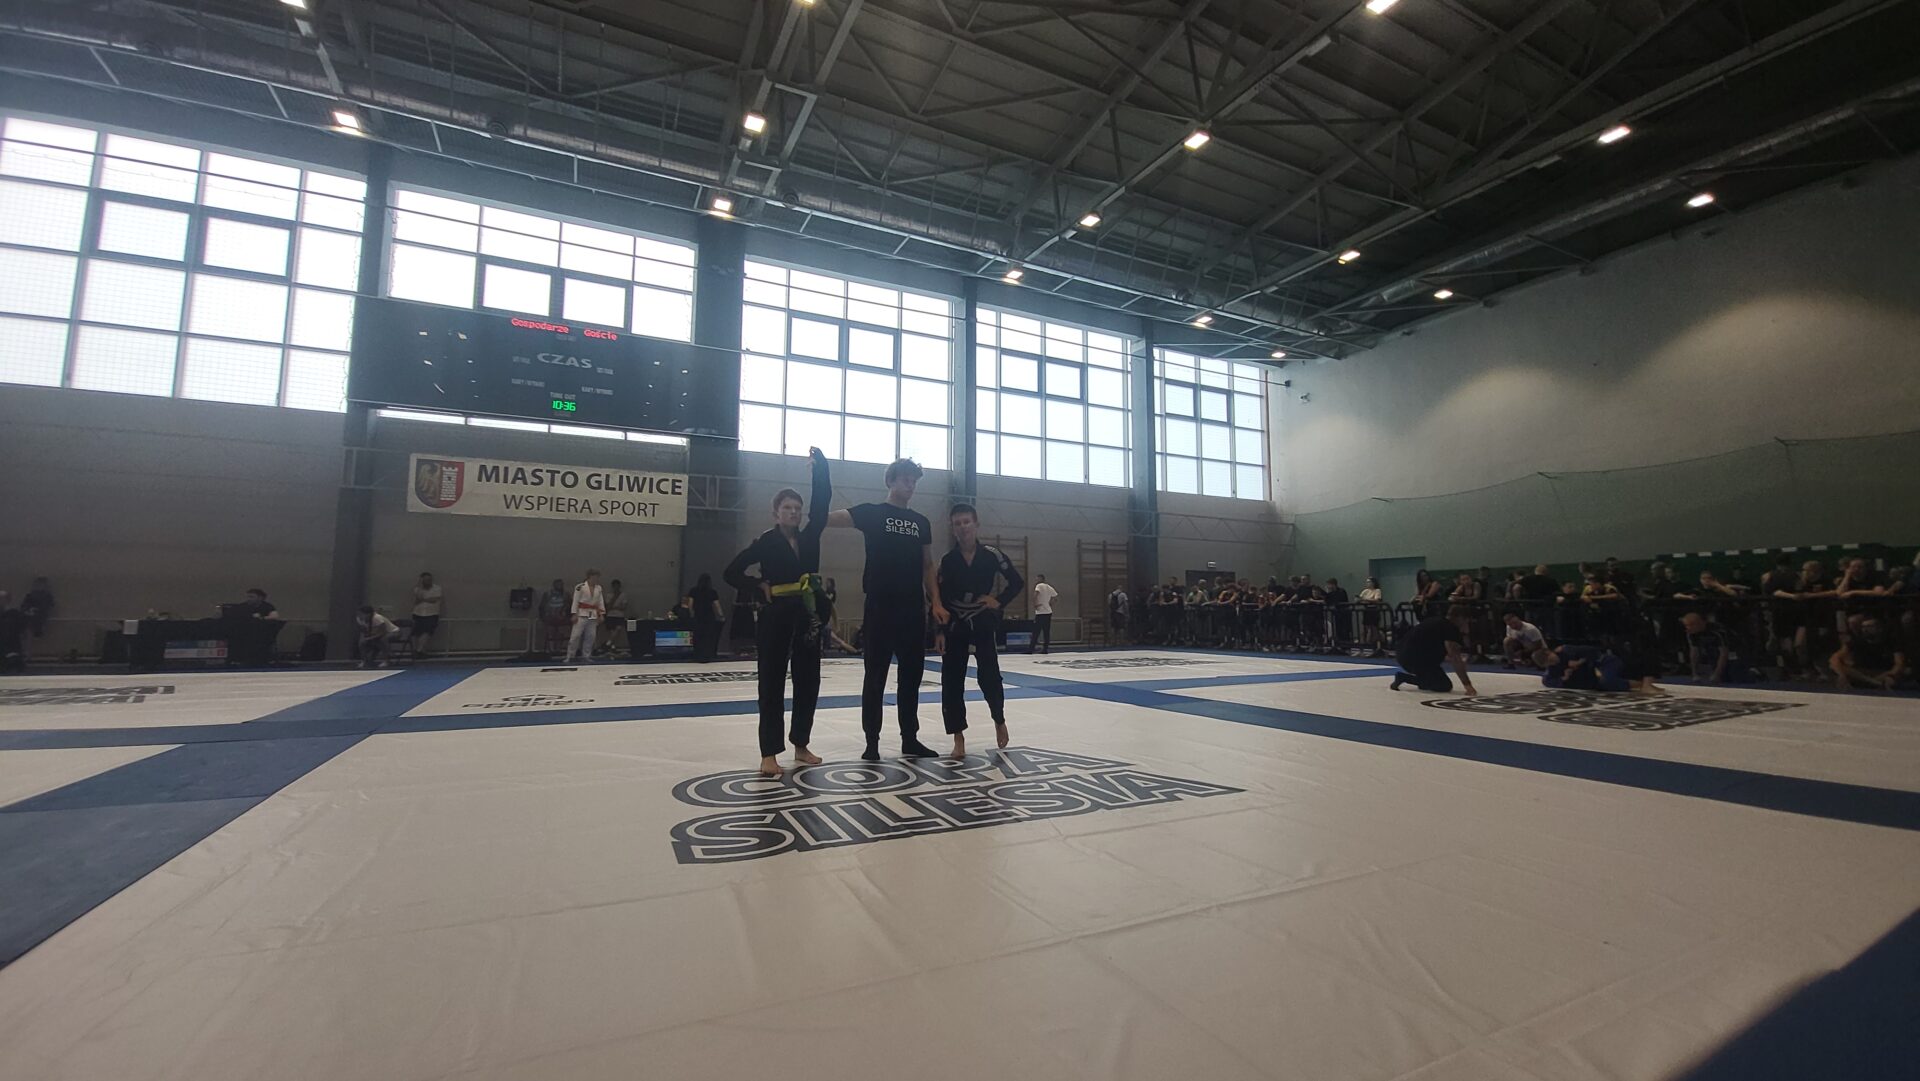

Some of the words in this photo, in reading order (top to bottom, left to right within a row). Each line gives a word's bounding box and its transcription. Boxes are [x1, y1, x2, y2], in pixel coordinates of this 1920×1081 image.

[511, 317, 569, 334] Gospodarze
[537, 353, 592, 369] CZAS
[552, 400, 576, 411] 10:36
[477, 464, 579, 489] MIASTO
[585, 472, 683, 496] GLIWICE
[503, 494, 592, 514] WSPIERA
[598, 500, 659, 517] SPORT
[885, 525, 920, 538] SILESIA
[886, 517, 919, 531] COPA
[672, 746, 1135, 808] COPA
[670, 769, 1247, 865] SILESIA
